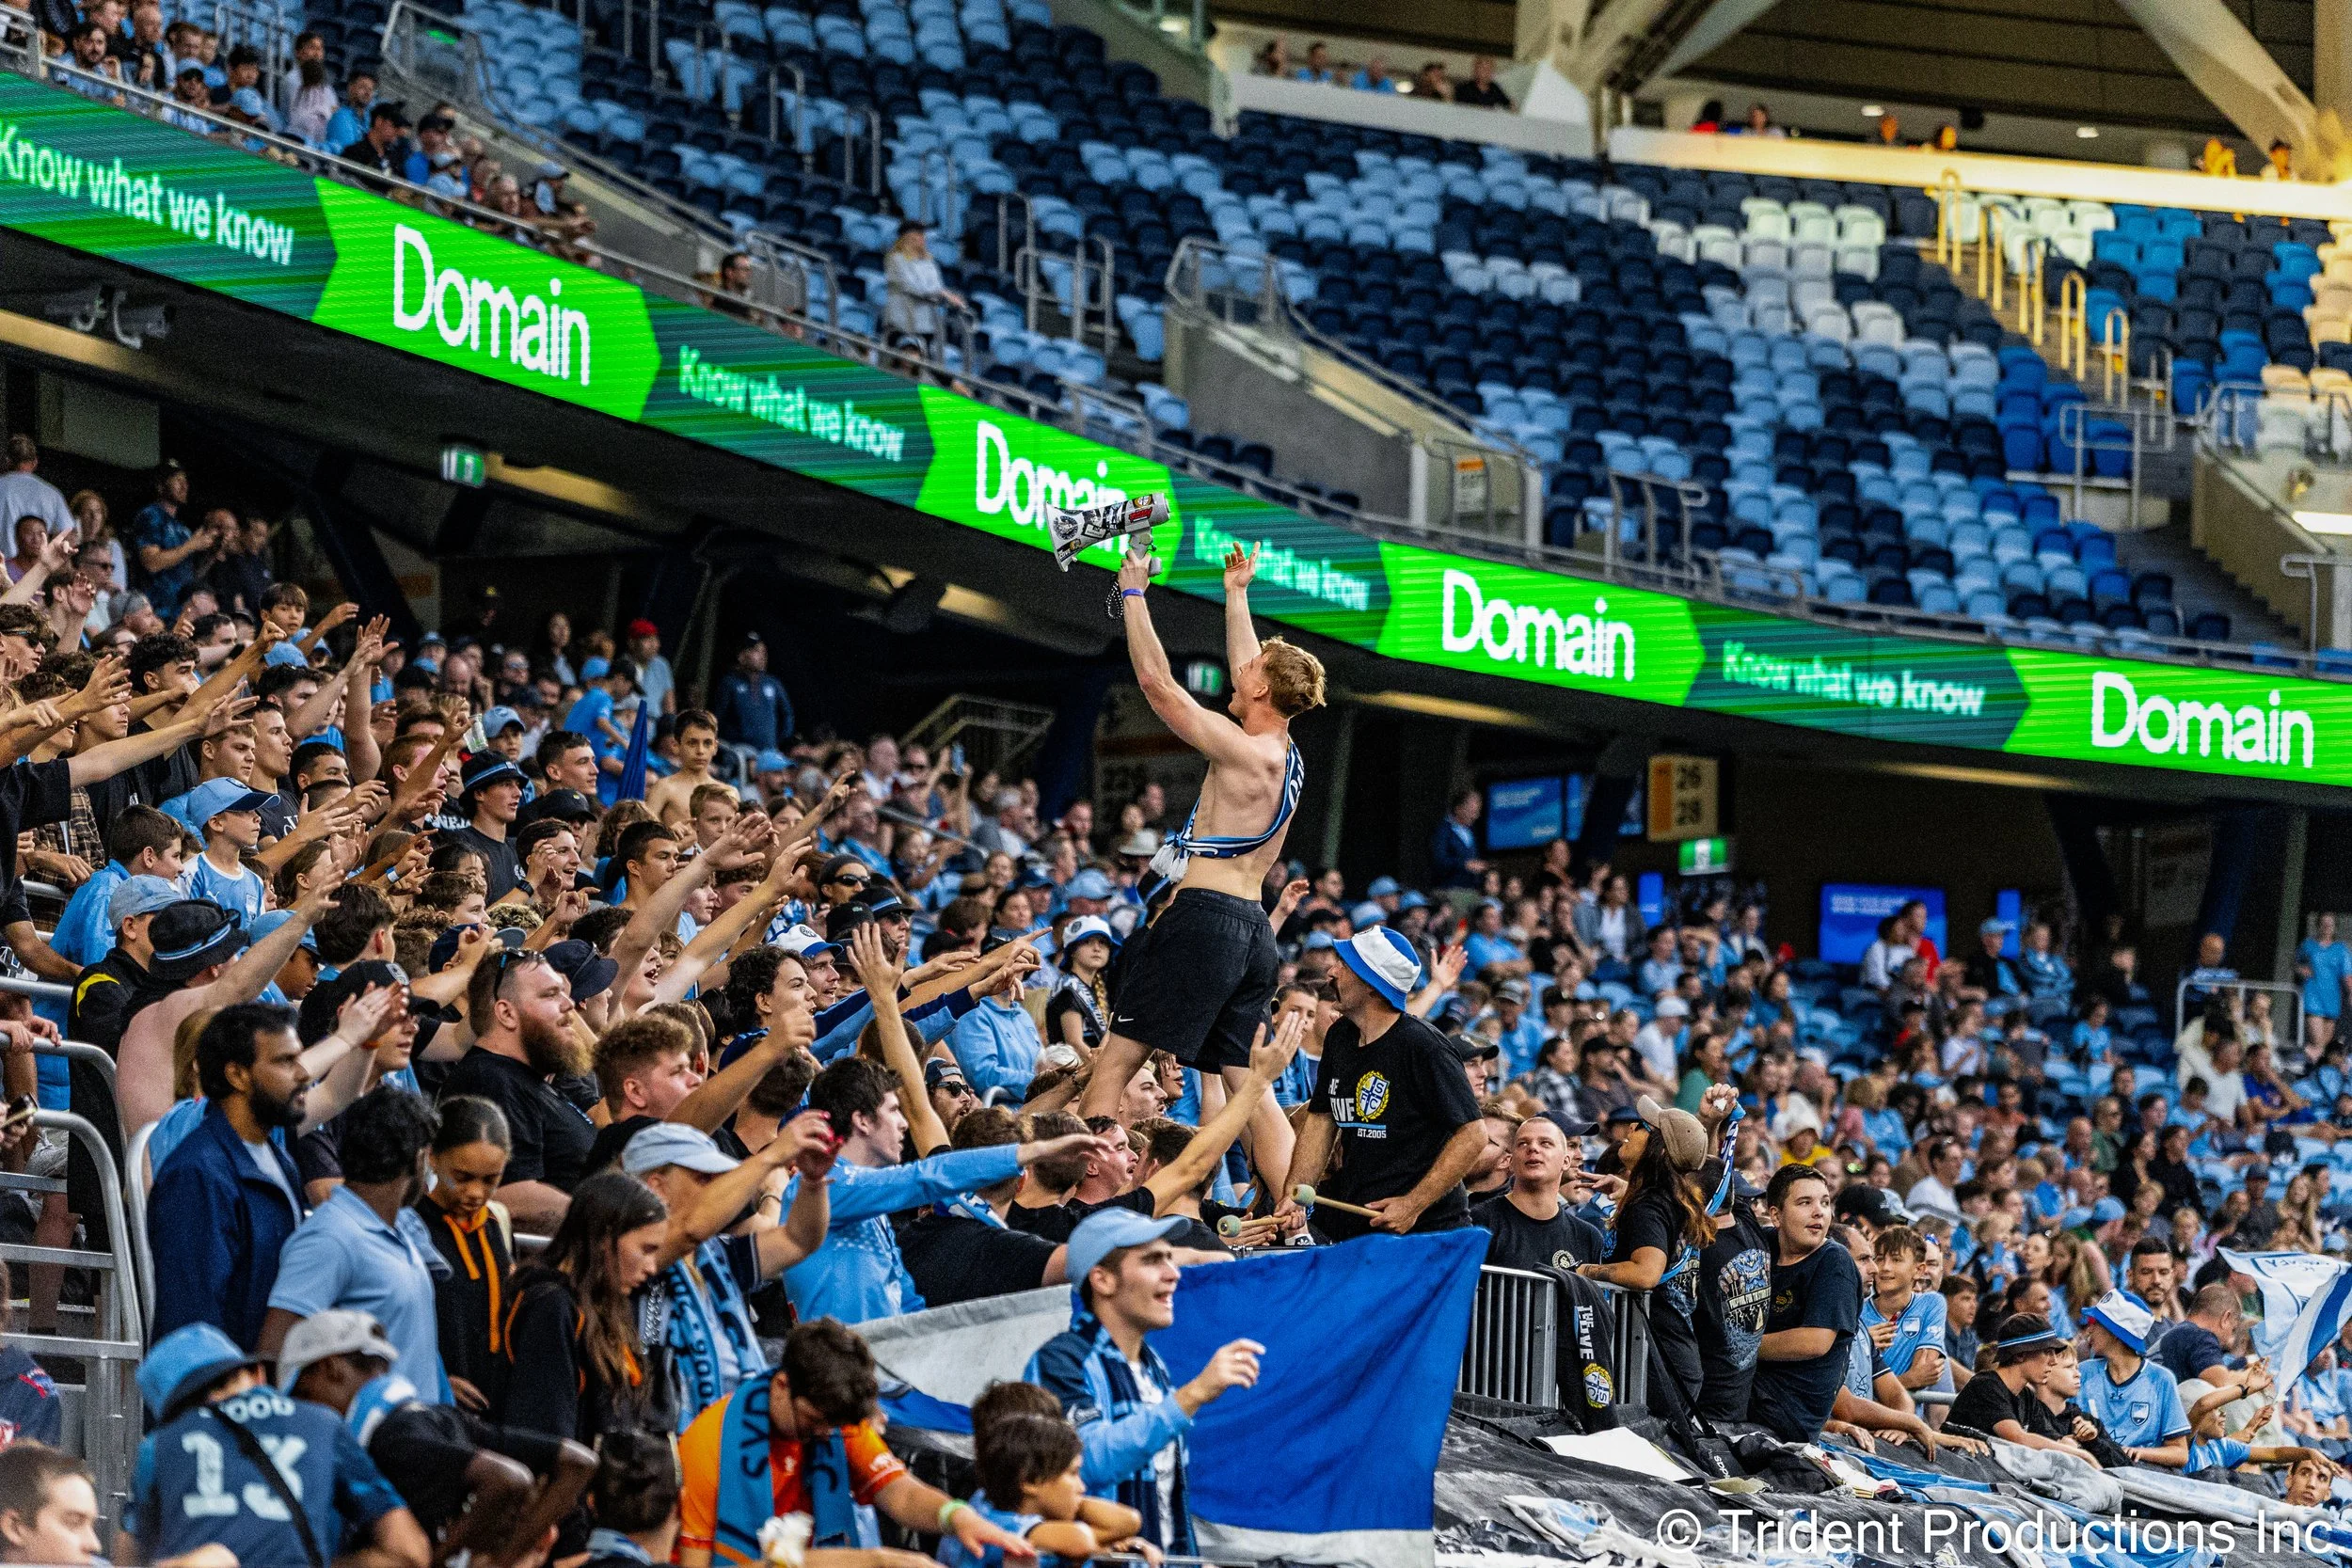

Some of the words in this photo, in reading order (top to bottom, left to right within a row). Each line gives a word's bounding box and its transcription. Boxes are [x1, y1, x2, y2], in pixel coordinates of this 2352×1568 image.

[0, 122, 82, 198] Know
[87, 156, 164, 225] what
[167, 187, 211, 239] we
[216, 193, 294, 266] know
[392, 223, 592, 387] Domain
[679, 344, 748, 412] Know
[749, 374, 807, 433] what
[808, 399, 843, 444] we
[844, 399, 906, 462] know
[1254, 538, 1295, 590] hat
[1321, 557, 1372, 611] know
[1441, 568, 1637, 681] Domain
[1723, 640, 1791, 690] Know
[1793, 656, 1853, 701] what
[1854, 673, 1898, 708] we
[1900, 669, 1987, 716] know
[2090, 671, 2316, 770] Domain
[1677, 763, 1701, 790] 26
[1327, 1078, 1340, 1096] HE
[1329, 1097, 1355, 1122] OVE
[1357, 1128, 1387, 1139] EST.2005
